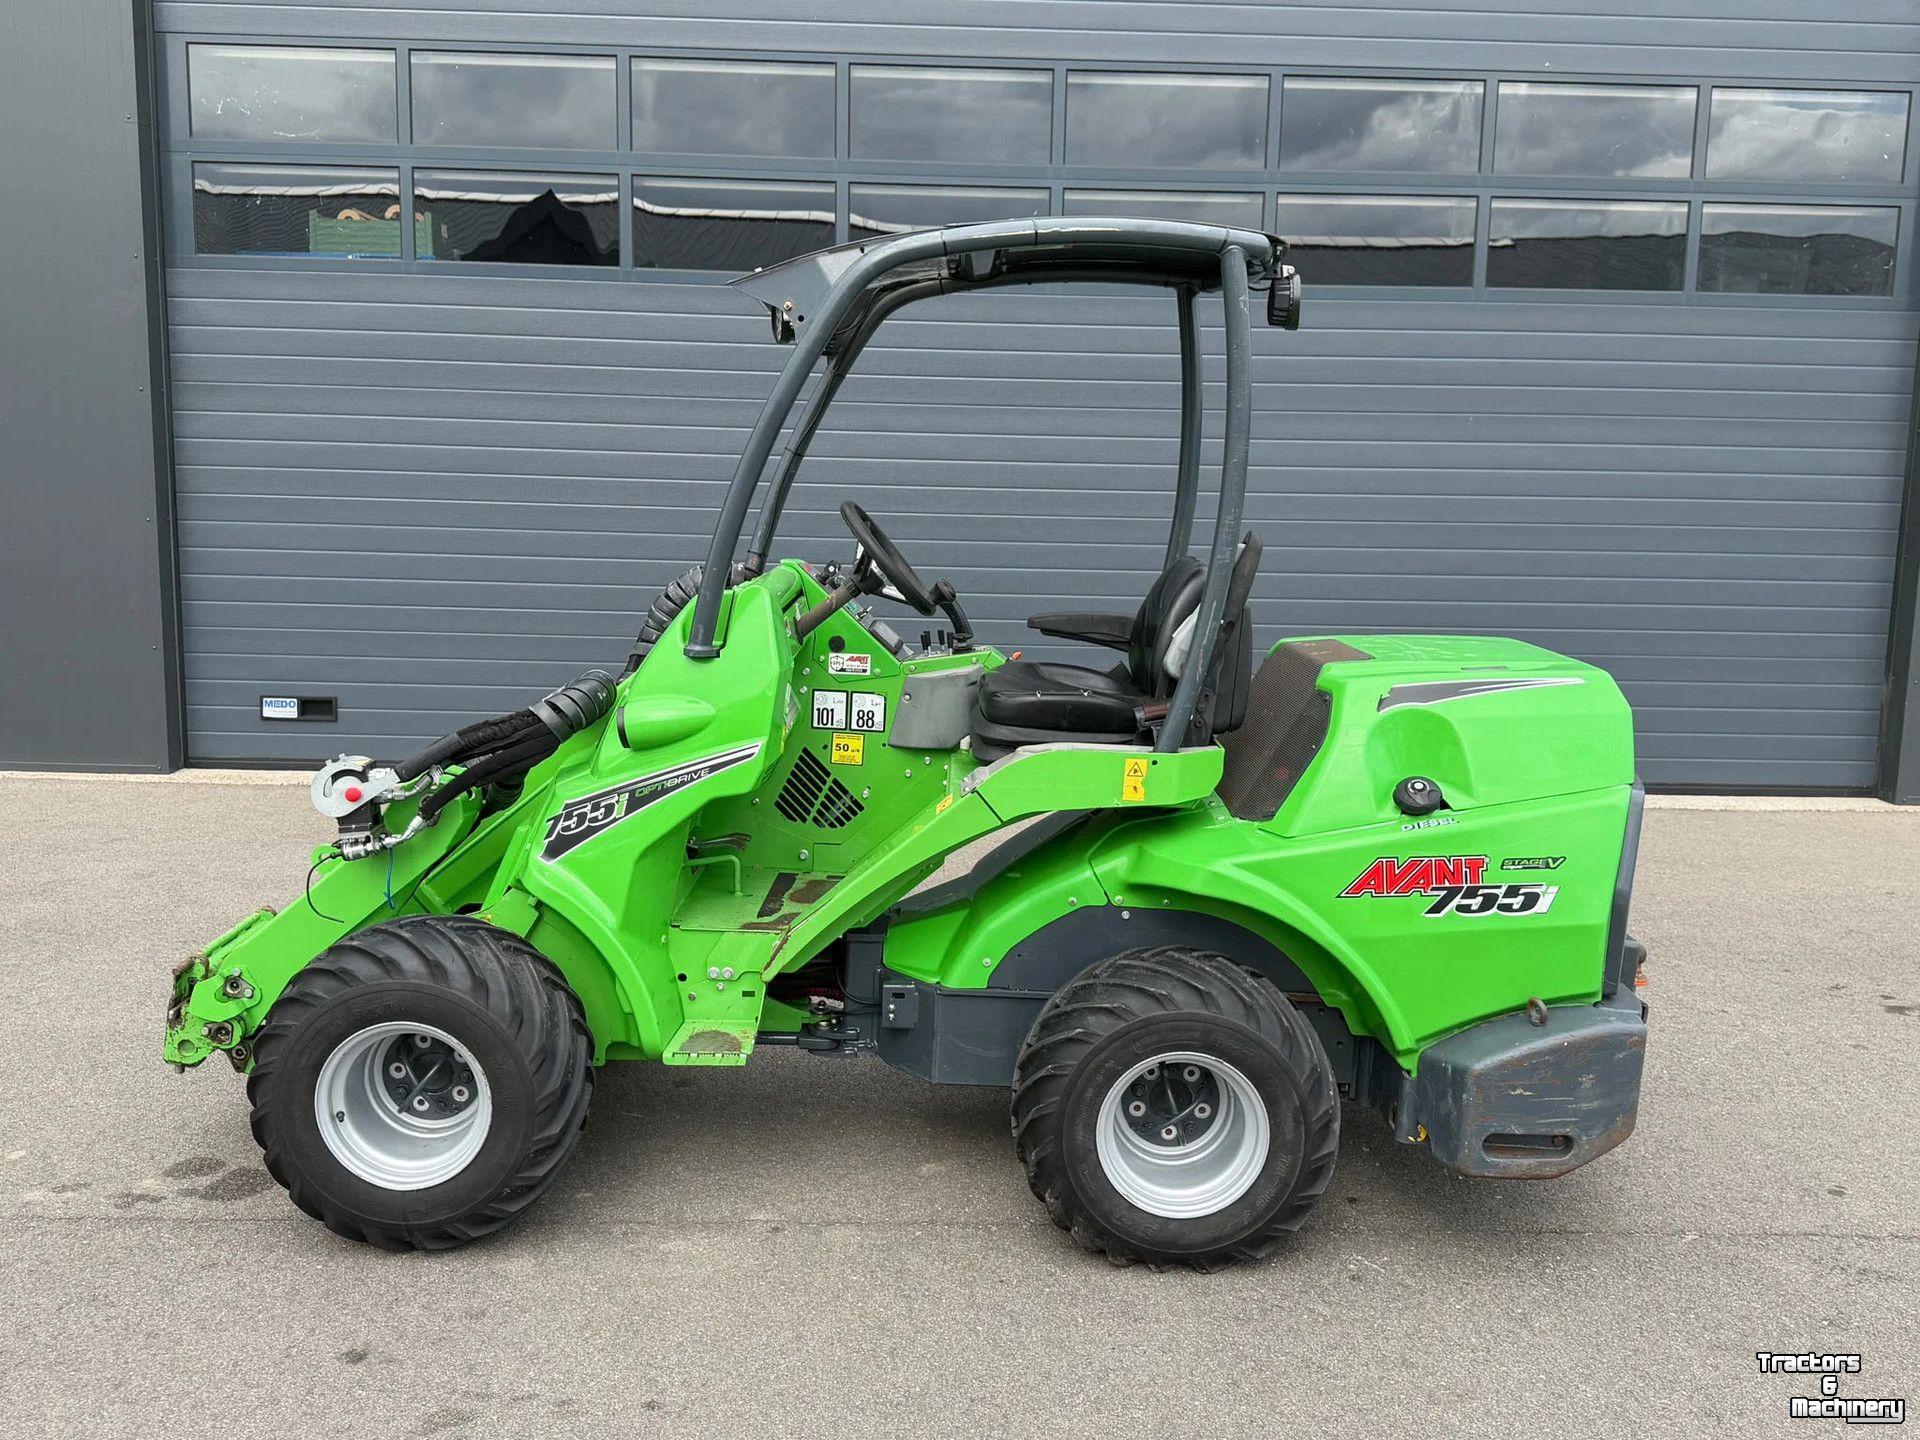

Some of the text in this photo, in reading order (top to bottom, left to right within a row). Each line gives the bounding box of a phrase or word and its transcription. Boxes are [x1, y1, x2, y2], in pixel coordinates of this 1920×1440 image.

[264, 700, 296, 708] MEDO
[816, 707, 835, 726] 101
[856, 709, 875, 729] 88
[835, 743, 850, 752] 50
[635, 767, 710, 797] OPTIDRIVE
[1338, 855, 1490, 897] AVANT
[1421, 884, 1562, 918] 755i
